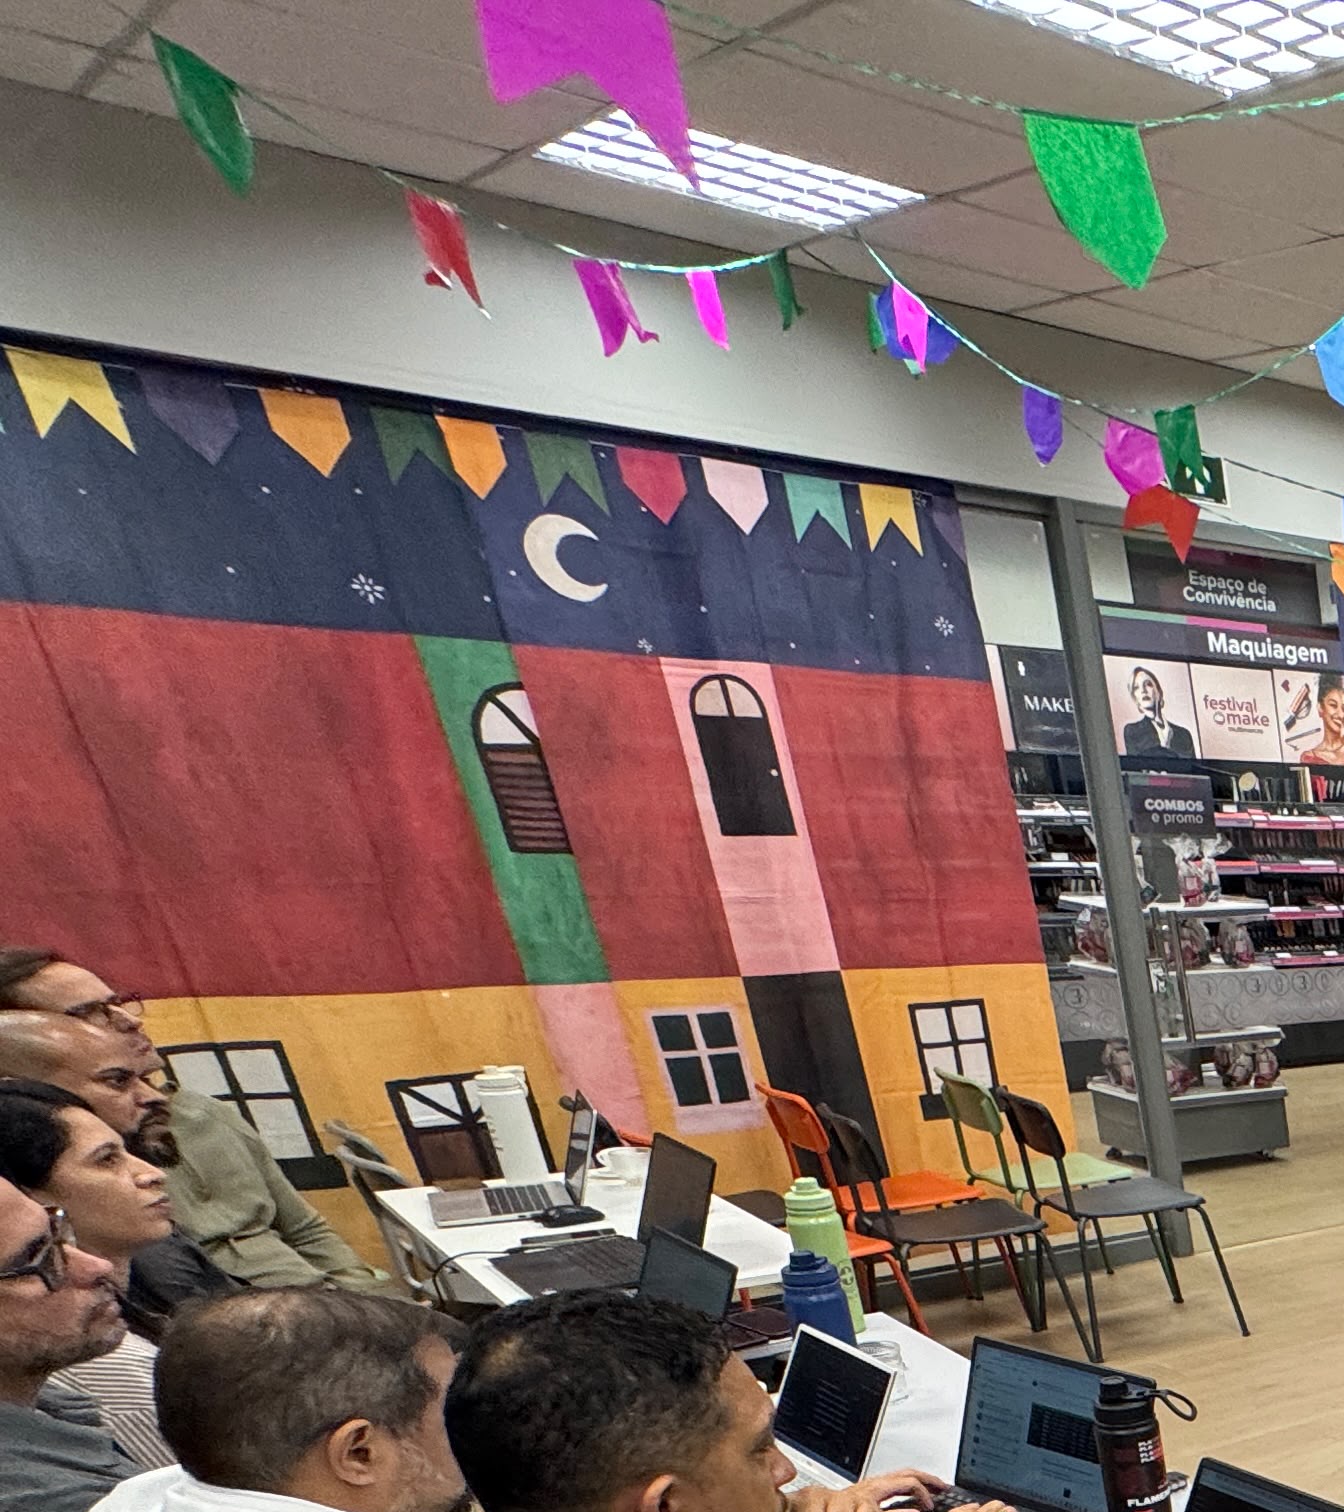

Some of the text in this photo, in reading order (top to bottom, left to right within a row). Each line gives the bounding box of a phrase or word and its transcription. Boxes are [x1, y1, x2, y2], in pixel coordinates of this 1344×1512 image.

[1188, 569, 1267, 595] Espaço de
[1182, 586, 1277, 612] Convivência
[1206, 631, 1328, 665] Maquiagem
[1203, 693, 1258, 713] festival
[1144, 798, 1205, 812] COMBOS
[1151, 812, 1204, 826] e promo
